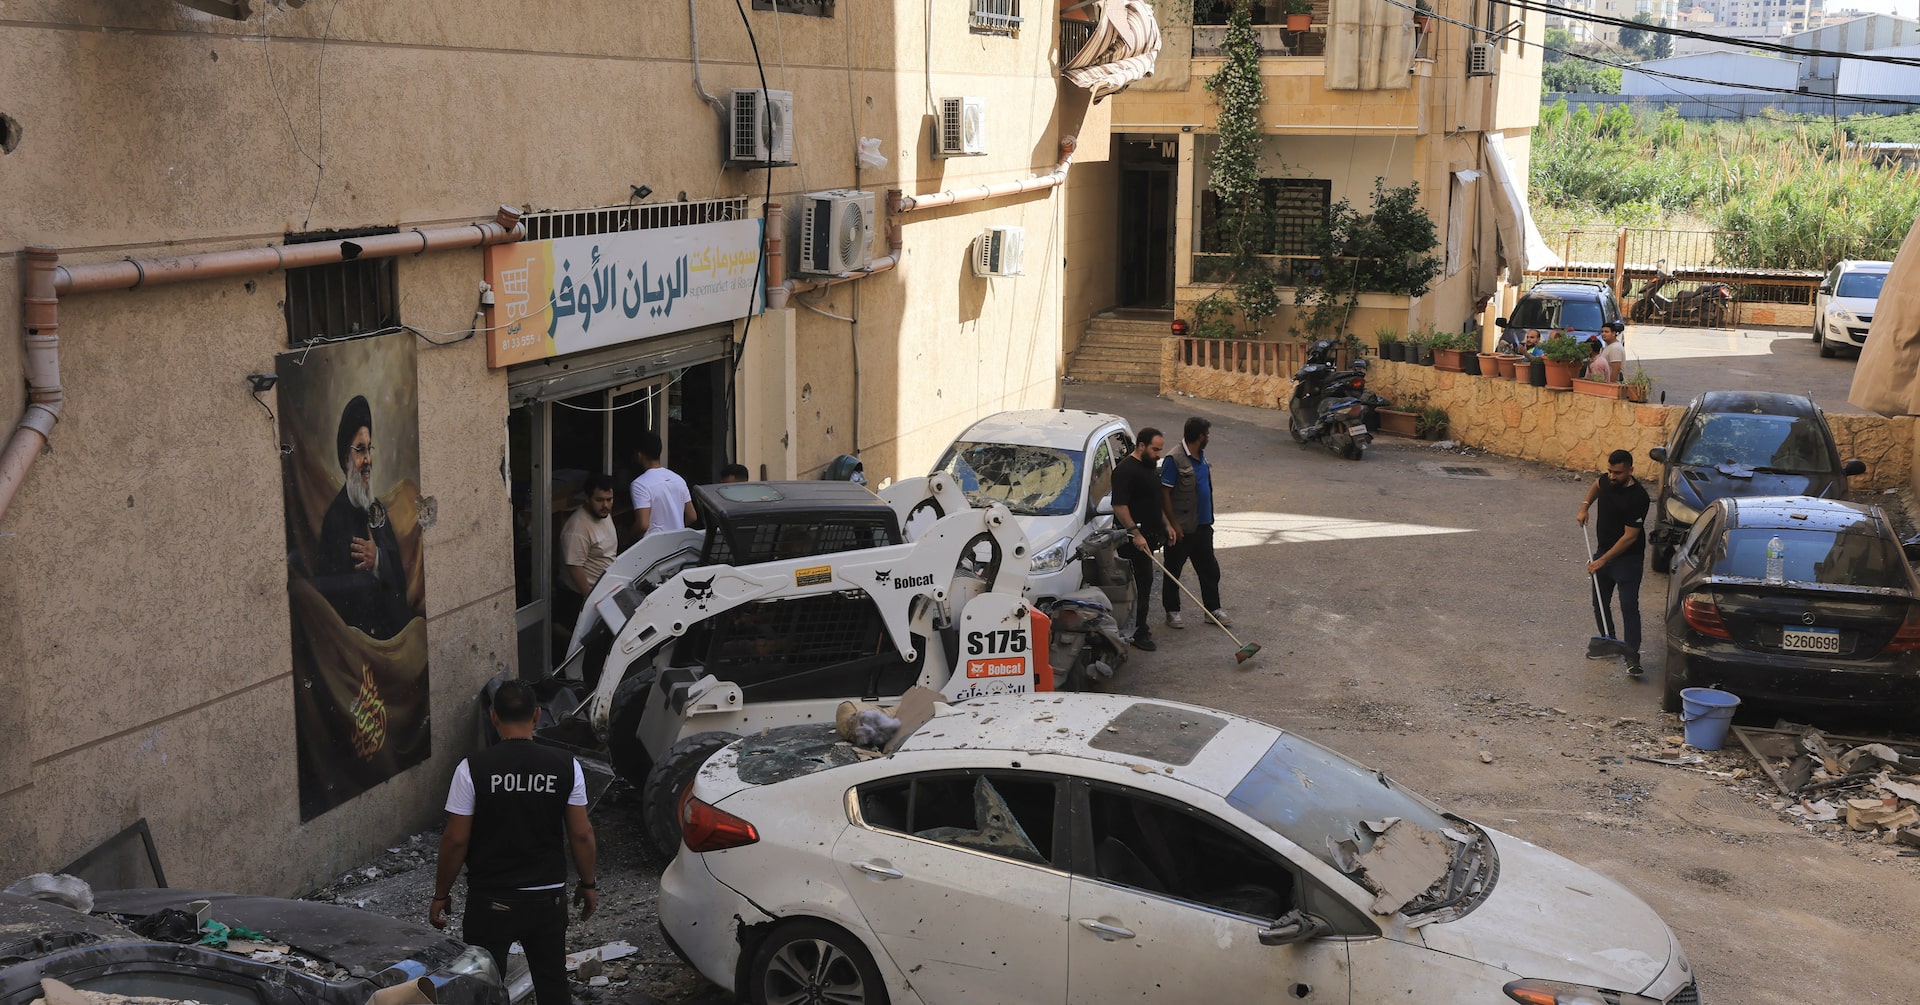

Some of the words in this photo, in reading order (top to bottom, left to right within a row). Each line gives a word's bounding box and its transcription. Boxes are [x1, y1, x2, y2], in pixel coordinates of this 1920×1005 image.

[1162, 141, 1176, 158] M
[689, 245, 756, 278] سوبرماركت
[547, 245, 617, 339] الأوفر
[623, 254, 688, 319] الريان
[894, 573, 934, 589] Bobcat
[967, 629, 1026, 655] S175
[1784, 634, 1839, 651] S260698
[987, 663, 1021, 676] Bobcat
[490, 773, 558, 793] POLICE
